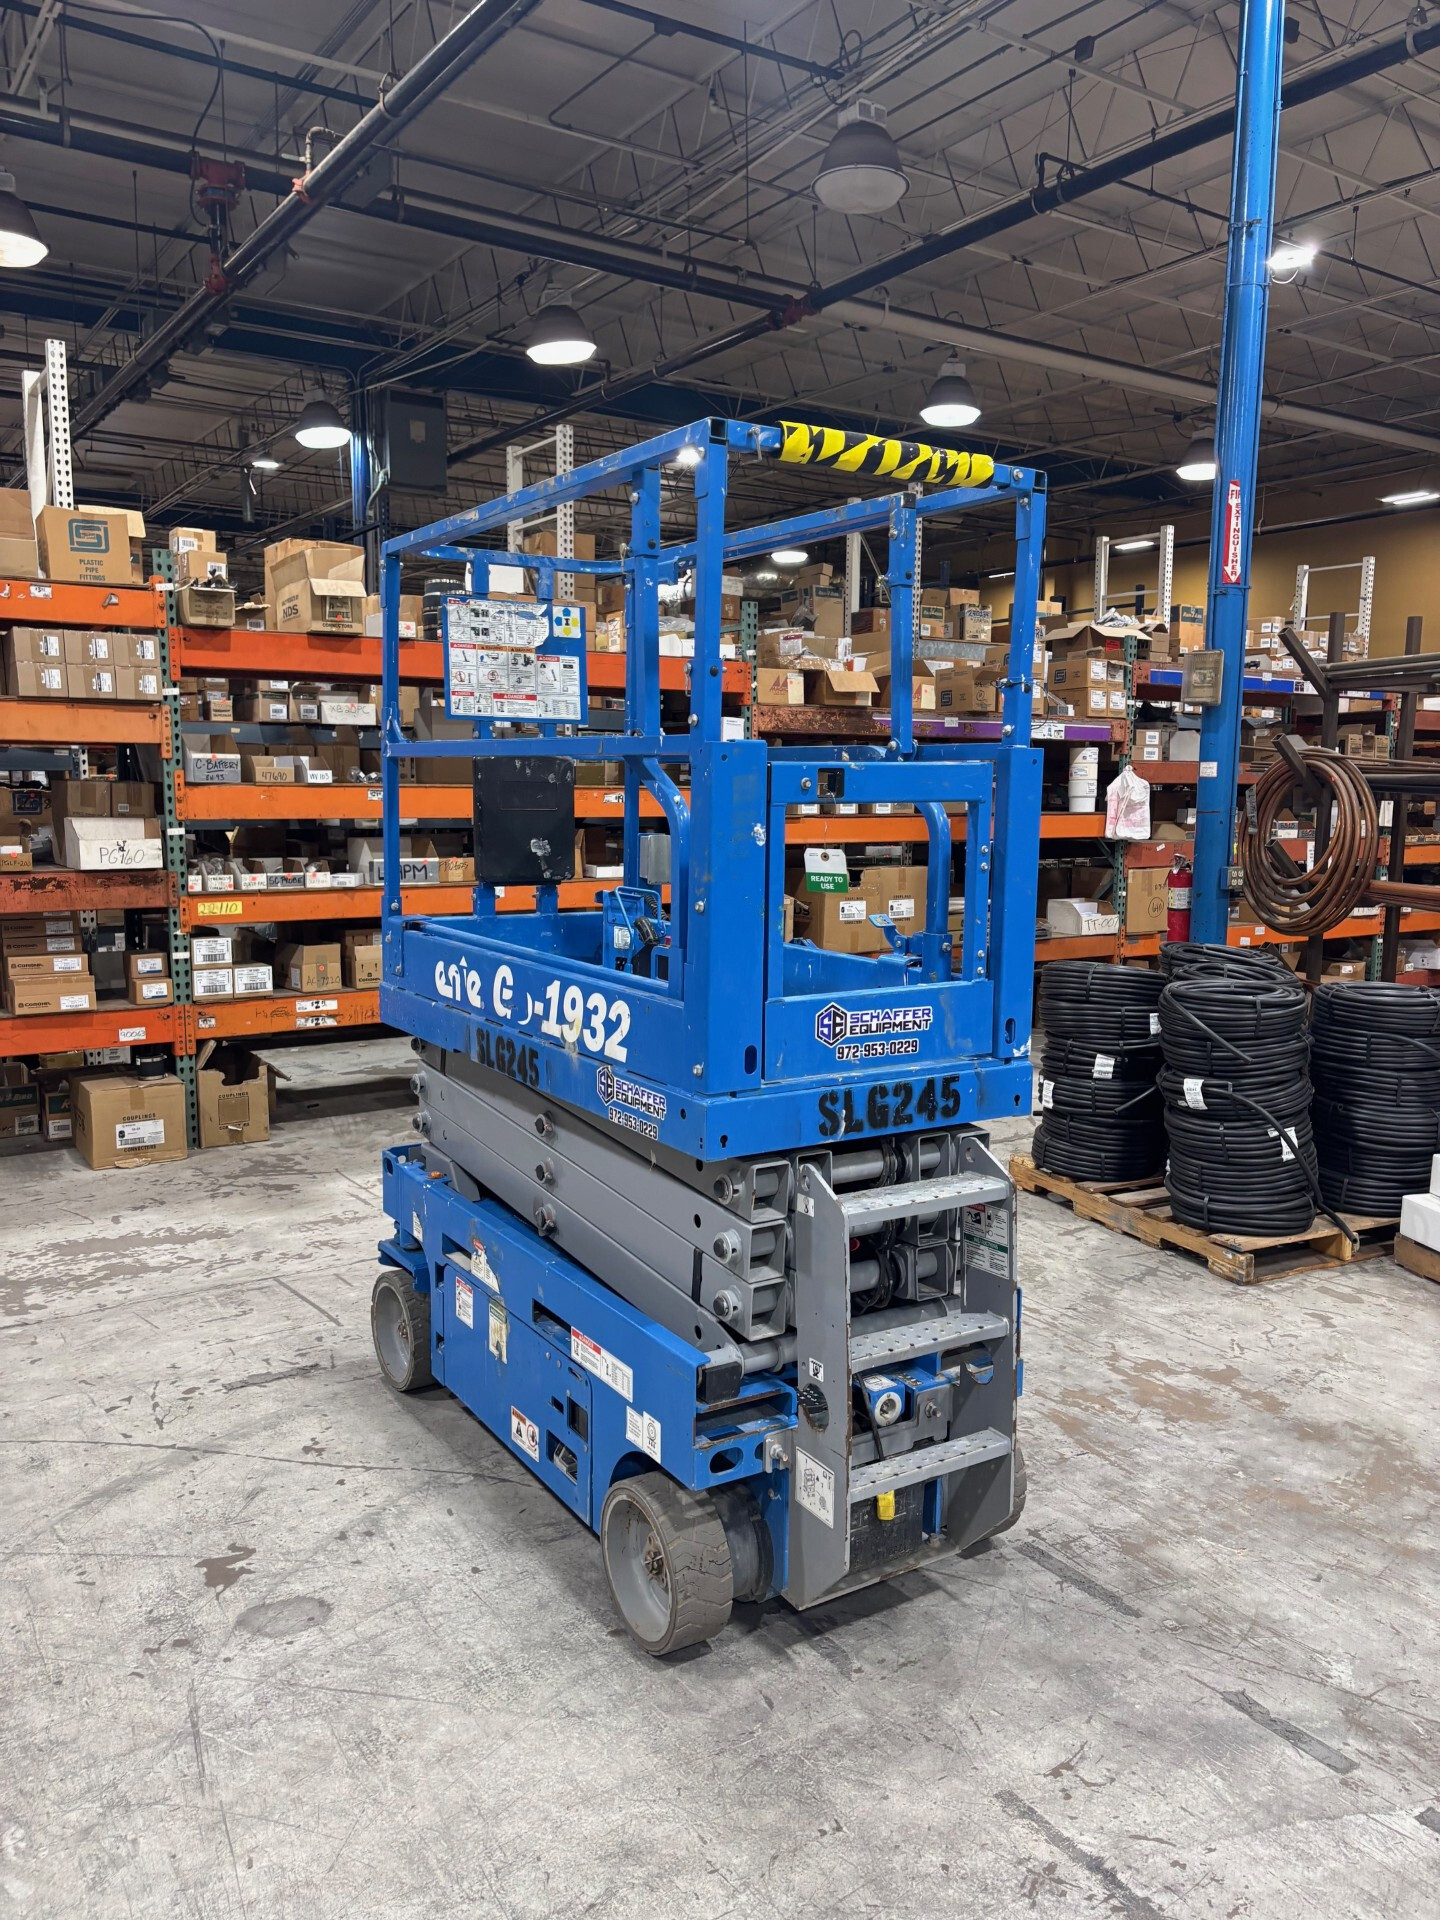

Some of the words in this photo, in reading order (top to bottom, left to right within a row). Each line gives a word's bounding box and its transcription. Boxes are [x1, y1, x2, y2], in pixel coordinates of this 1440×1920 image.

[1230, 502, 1241, 577] EXTINGUISHER
[79, 558, 104, 567] PLASTIC
[85, 566, 99, 574] PIPE
[79, 573, 106, 582] FITTINGS
[282, 603, 299, 620] NDS
[850, 1008, 932, 1024] SCHAFFER
[850, 1018, 932, 1036] EQUIPMENT
[476, 1027, 540, 1087] SLG245
[837, 1039, 918, 1060] 972-953-0229
[218, 1091, 249, 1099] COUPLINGS
[615, 1079, 666, 1108] SCHAFFER
[615, 1090, 666, 1120] EQUIPMENT
[818, 1073, 961, 1137] SLG245
[609, 1107, 659, 1140] 972-953-0229
